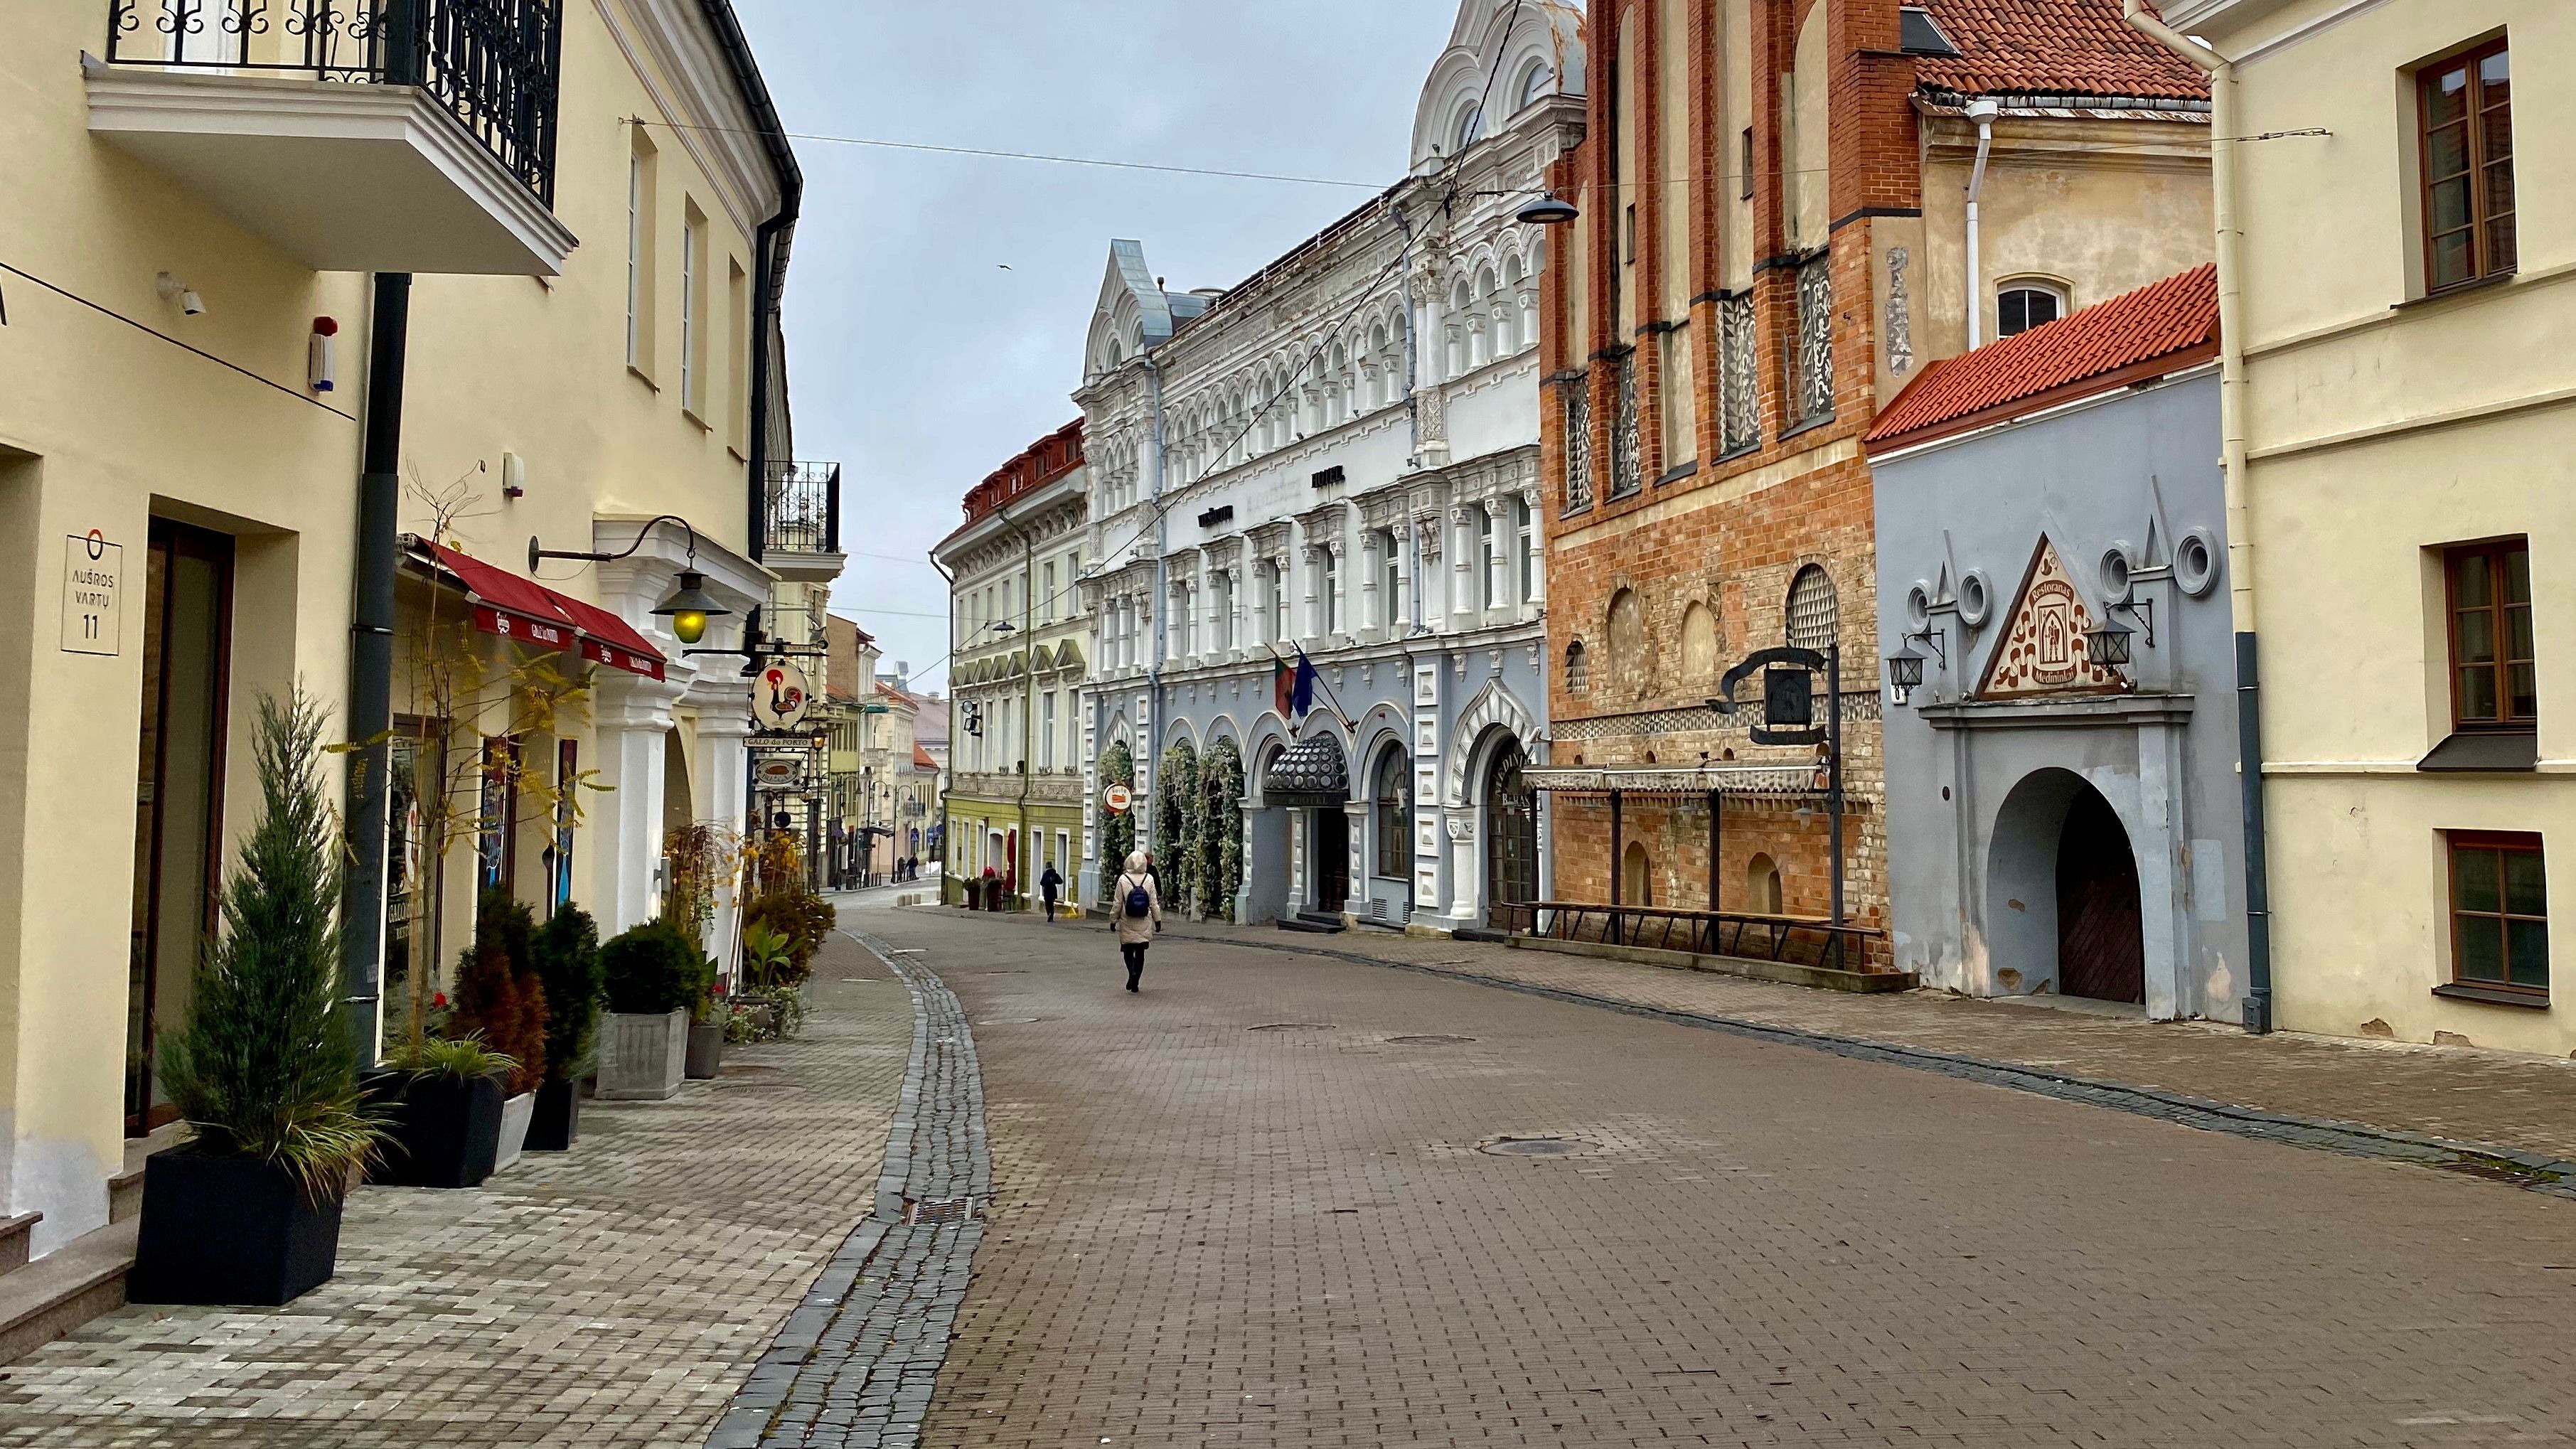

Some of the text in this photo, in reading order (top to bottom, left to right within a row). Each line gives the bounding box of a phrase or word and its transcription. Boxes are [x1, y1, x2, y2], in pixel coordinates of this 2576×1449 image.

[73, 568, 114, 588] AUŠROS
[75, 590, 109, 609] VARTŲ
[2031, 583, 2071, 601] Restoranas
[83, 614, 97, 639] 11
[2034, 667, 2075, 683] Medininkai
